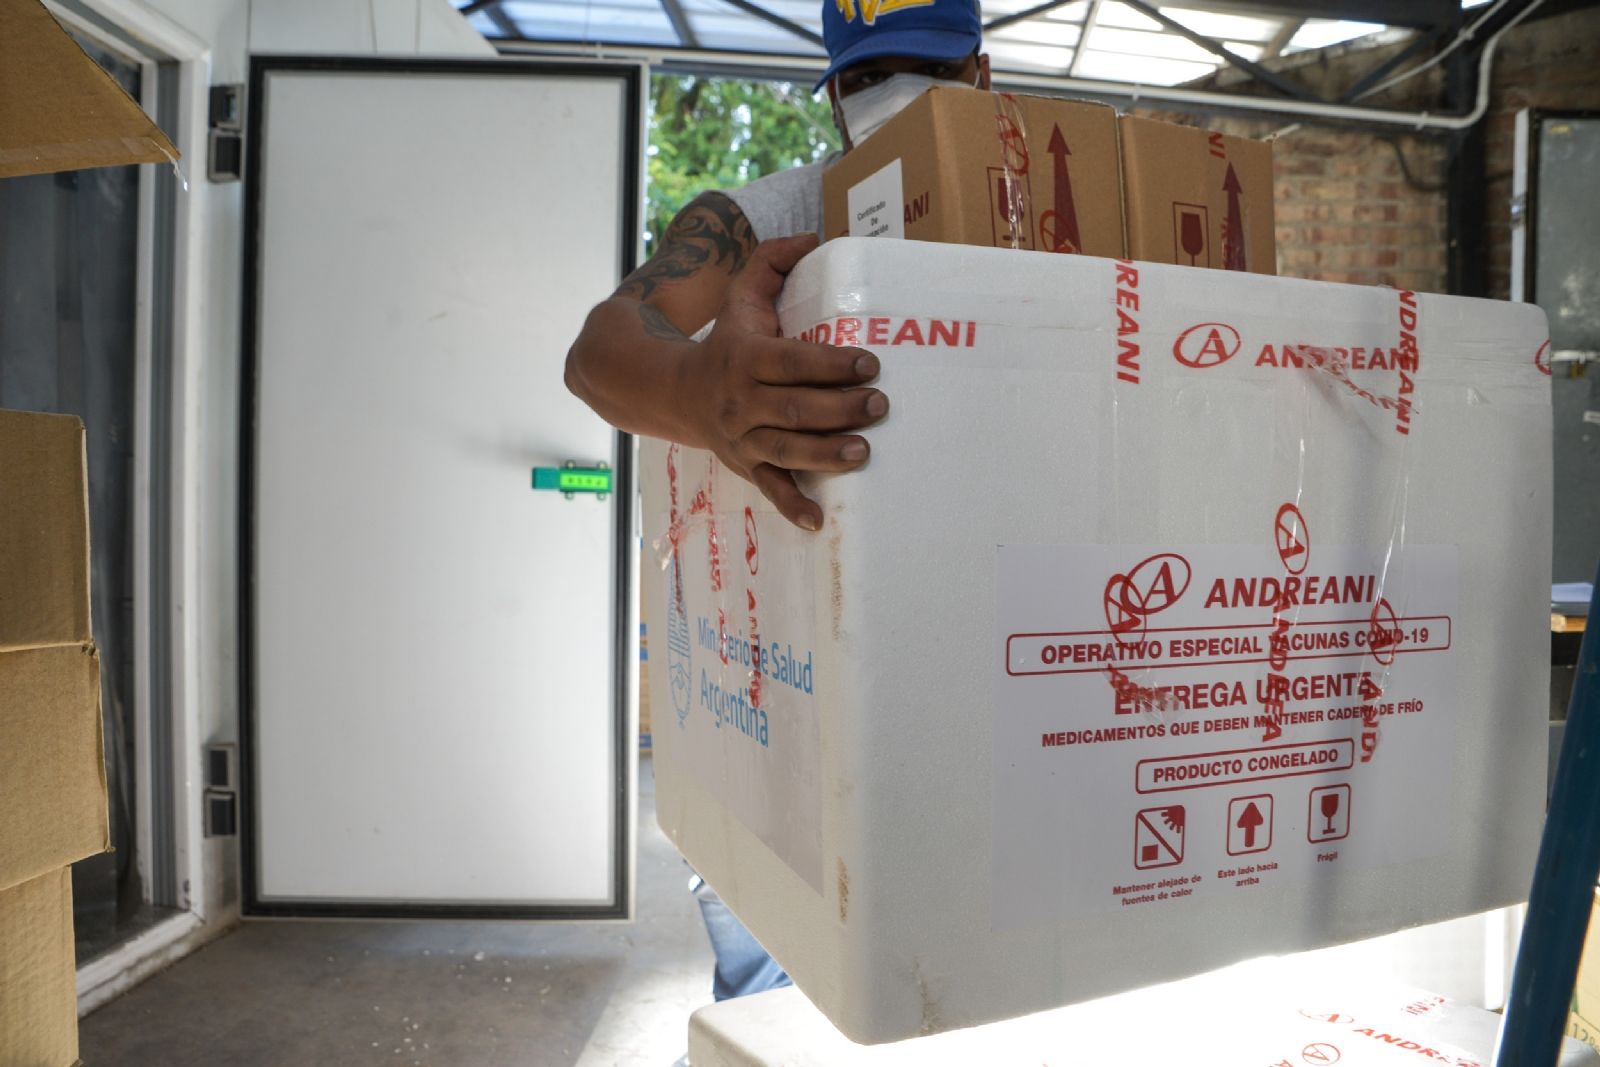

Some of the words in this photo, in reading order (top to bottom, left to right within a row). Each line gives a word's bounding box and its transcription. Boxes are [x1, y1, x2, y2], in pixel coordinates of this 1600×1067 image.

[793, 317, 977, 348] NDREANI
[1203, 575, 1376, 609] ANDREANI
[1041, 639, 1163, 665] OPERATIVO
[1169, 635, 1263, 658] ESPECIAL
[1268, 632, 1350, 653] VACUNAS
[771, 641, 813, 695] Salud
[700, 667, 769, 748] Argentina
[1114, 680, 1248, 716] ENTREGA
[1256, 671, 1372, 704] URGENTE
[1041, 723, 1166, 748] MEDICAMENTOS
[1170, 721, 1200, 737] QUE
[1203, 717, 1250, 733] DEBEN
[1253, 709, 1324, 727] MANTENER
[1379, 703, 1396, 716] DE
[1401, 697, 1424, 714] FRÍO
[1153, 759, 1243, 783] PRODUCTO
[1247, 748, 1339, 772] CONGELADO
[1112, 881, 1155, 895] Mantener
[1157, 876, 1188, 890] alejado
[1191, 874, 1202, 883] de
[1217, 869, 1236, 879] Este
[1238, 865, 1255, 876] lado
[1257, 861, 1278, 872] hacia
[1236, 876, 1260, 887] arriba
[1121, 892, 1155, 906] fuentes
[1157, 889, 1168, 900] de
[1171, 887, 1193, 899] calor
